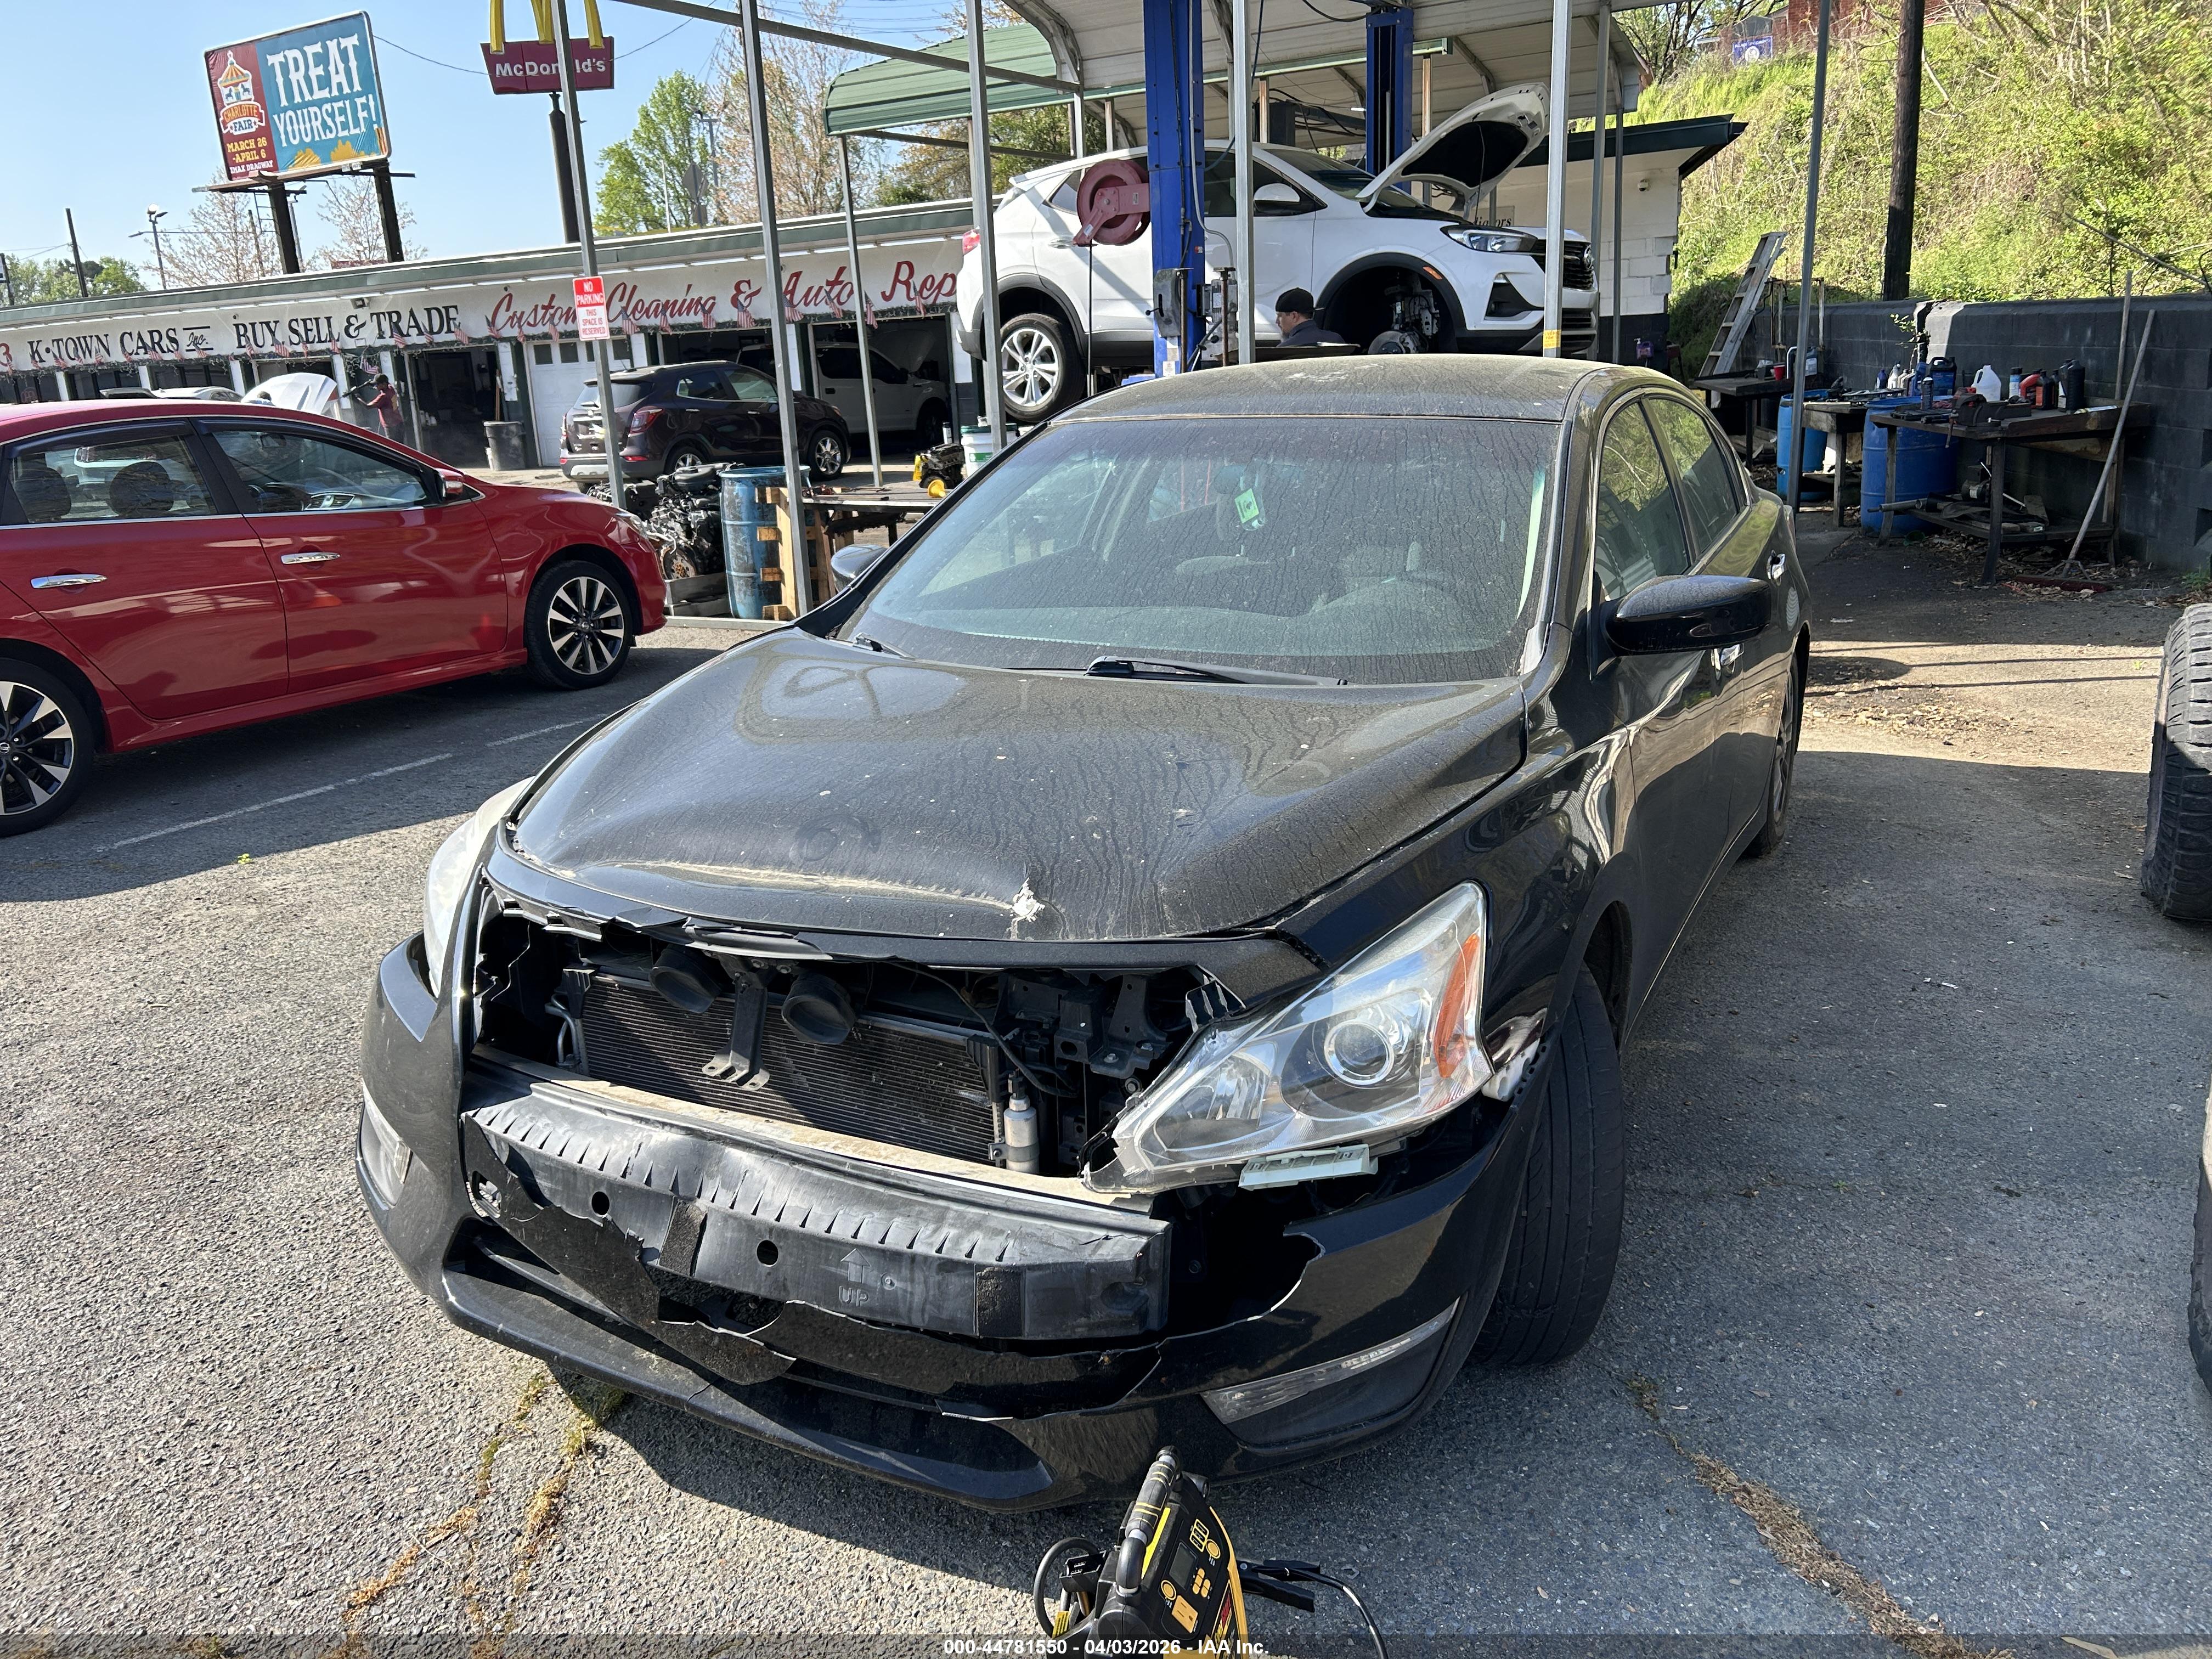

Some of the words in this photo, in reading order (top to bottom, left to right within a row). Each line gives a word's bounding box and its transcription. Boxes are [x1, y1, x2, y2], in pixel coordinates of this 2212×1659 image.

[266, 33, 363, 107] TREAT
[496, 58, 606, 77] McDonld's
[223, 103, 258, 123] CHARLOTTE
[272, 94, 377, 146] YOURSELF!
[233, 119, 253, 132] FAIR
[227, 139, 255, 153] MARCH
[257, 137, 267, 147] 26
[260, 149, 267, 159] 6
[246, 160, 273, 171] DRAGWAY
[583, 281, 594, 292] NO
[605, 282, 716, 323] Cleaning
[730, 279, 762, 308] &
[783, 266, 854, 308] Auto
[576, 292, 603, 305] PARKING
[289, 315, 340, 346] SELL
[343, 314, 366, 339] &
[370, 305, 460, 340] TRADE
[582, 326, 606, 335] RESERVED
[120, 328, 179, 356] CARS
[838, 1286, 869, 1306] UP
